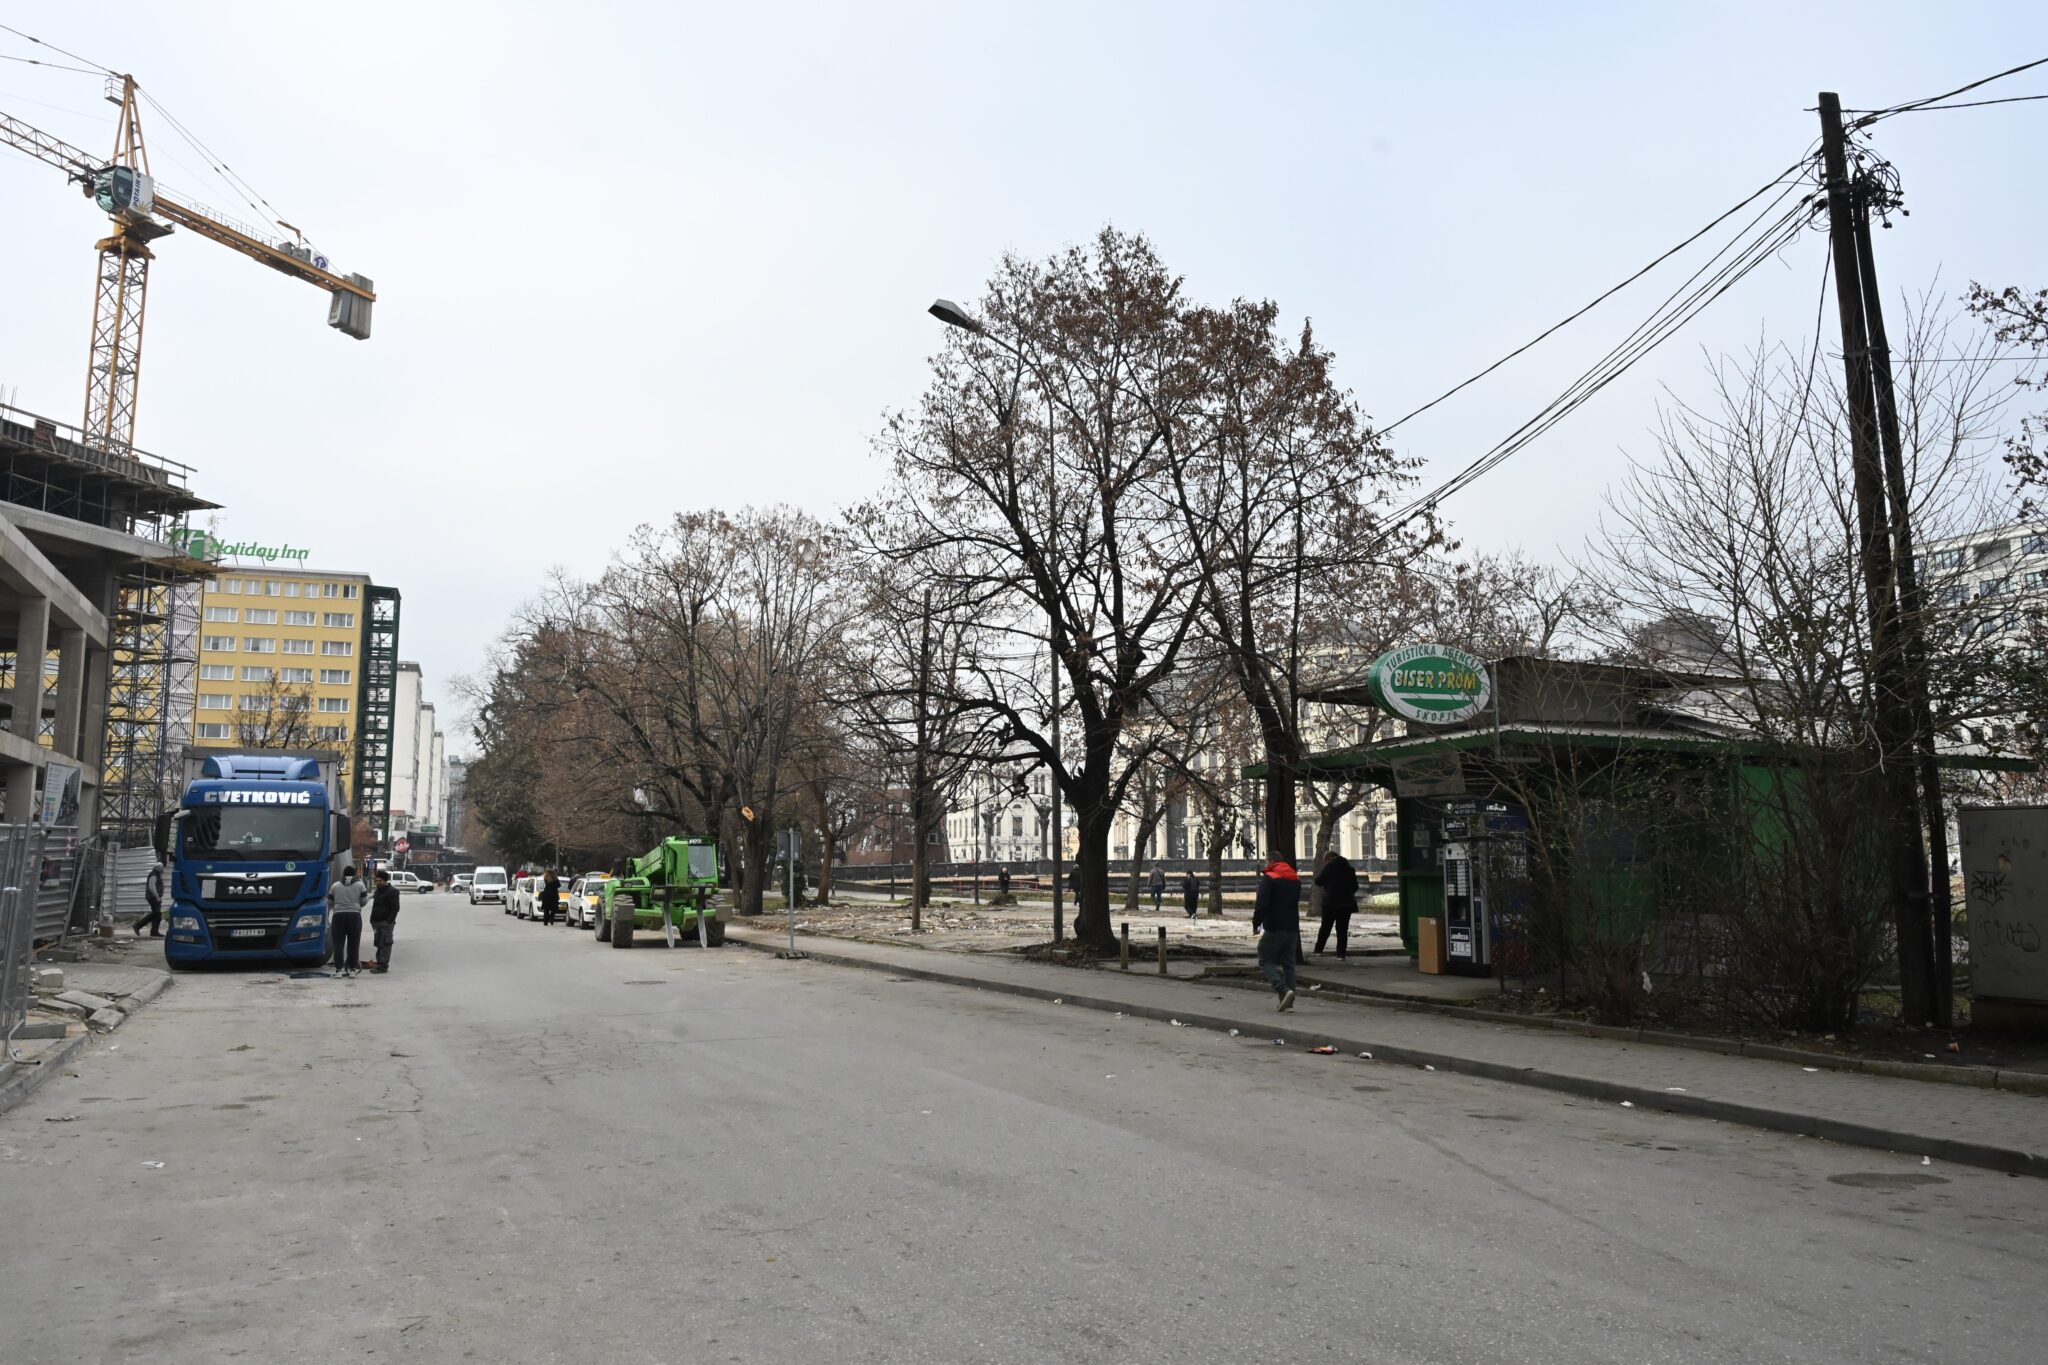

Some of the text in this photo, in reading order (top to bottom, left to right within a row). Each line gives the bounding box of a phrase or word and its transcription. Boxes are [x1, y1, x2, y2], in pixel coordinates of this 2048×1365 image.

[132, 180, 141, 208] POTAIN
[281, 544, 309, 559] Inn
[1386, 644, 1436, 671] TURISTIČKA
[1394, 669, 1476, 689] BISER PROM
[1415, 709, 1458, 721] SKOPJE
[204, 791, 310, 804] CVETKOVIĆ
[228, 885, 273, 895] MAN
